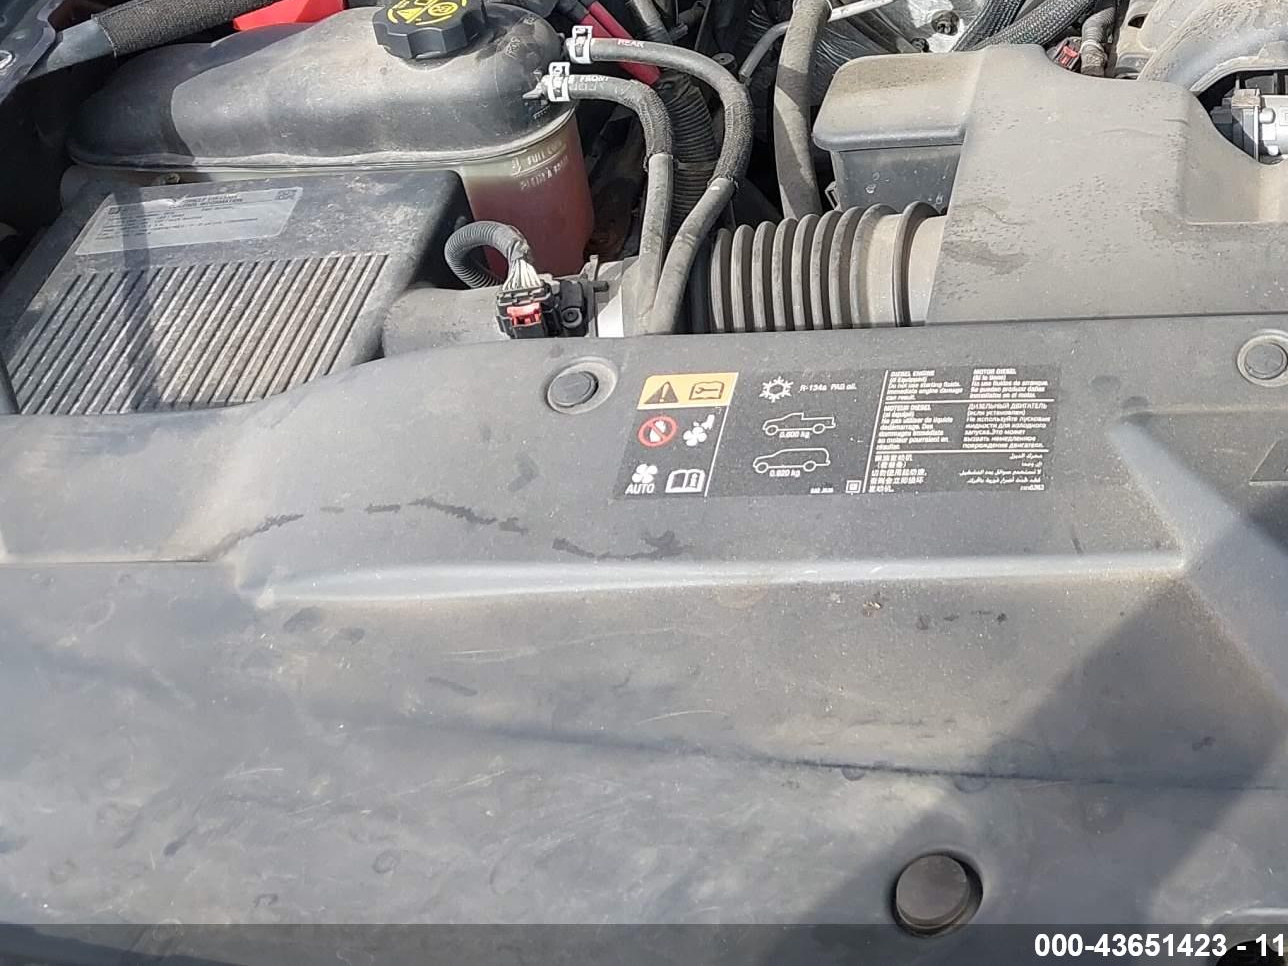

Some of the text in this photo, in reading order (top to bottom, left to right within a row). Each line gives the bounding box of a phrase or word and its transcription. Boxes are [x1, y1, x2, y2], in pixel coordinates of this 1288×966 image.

[618, 39, 644, 48] REAR
[800, 384, 827, 392] R-134a
[800, 431, 810, 439] kg
[791, 469, 800, 478] kg
[625, 484, 655, 494] AUTO
